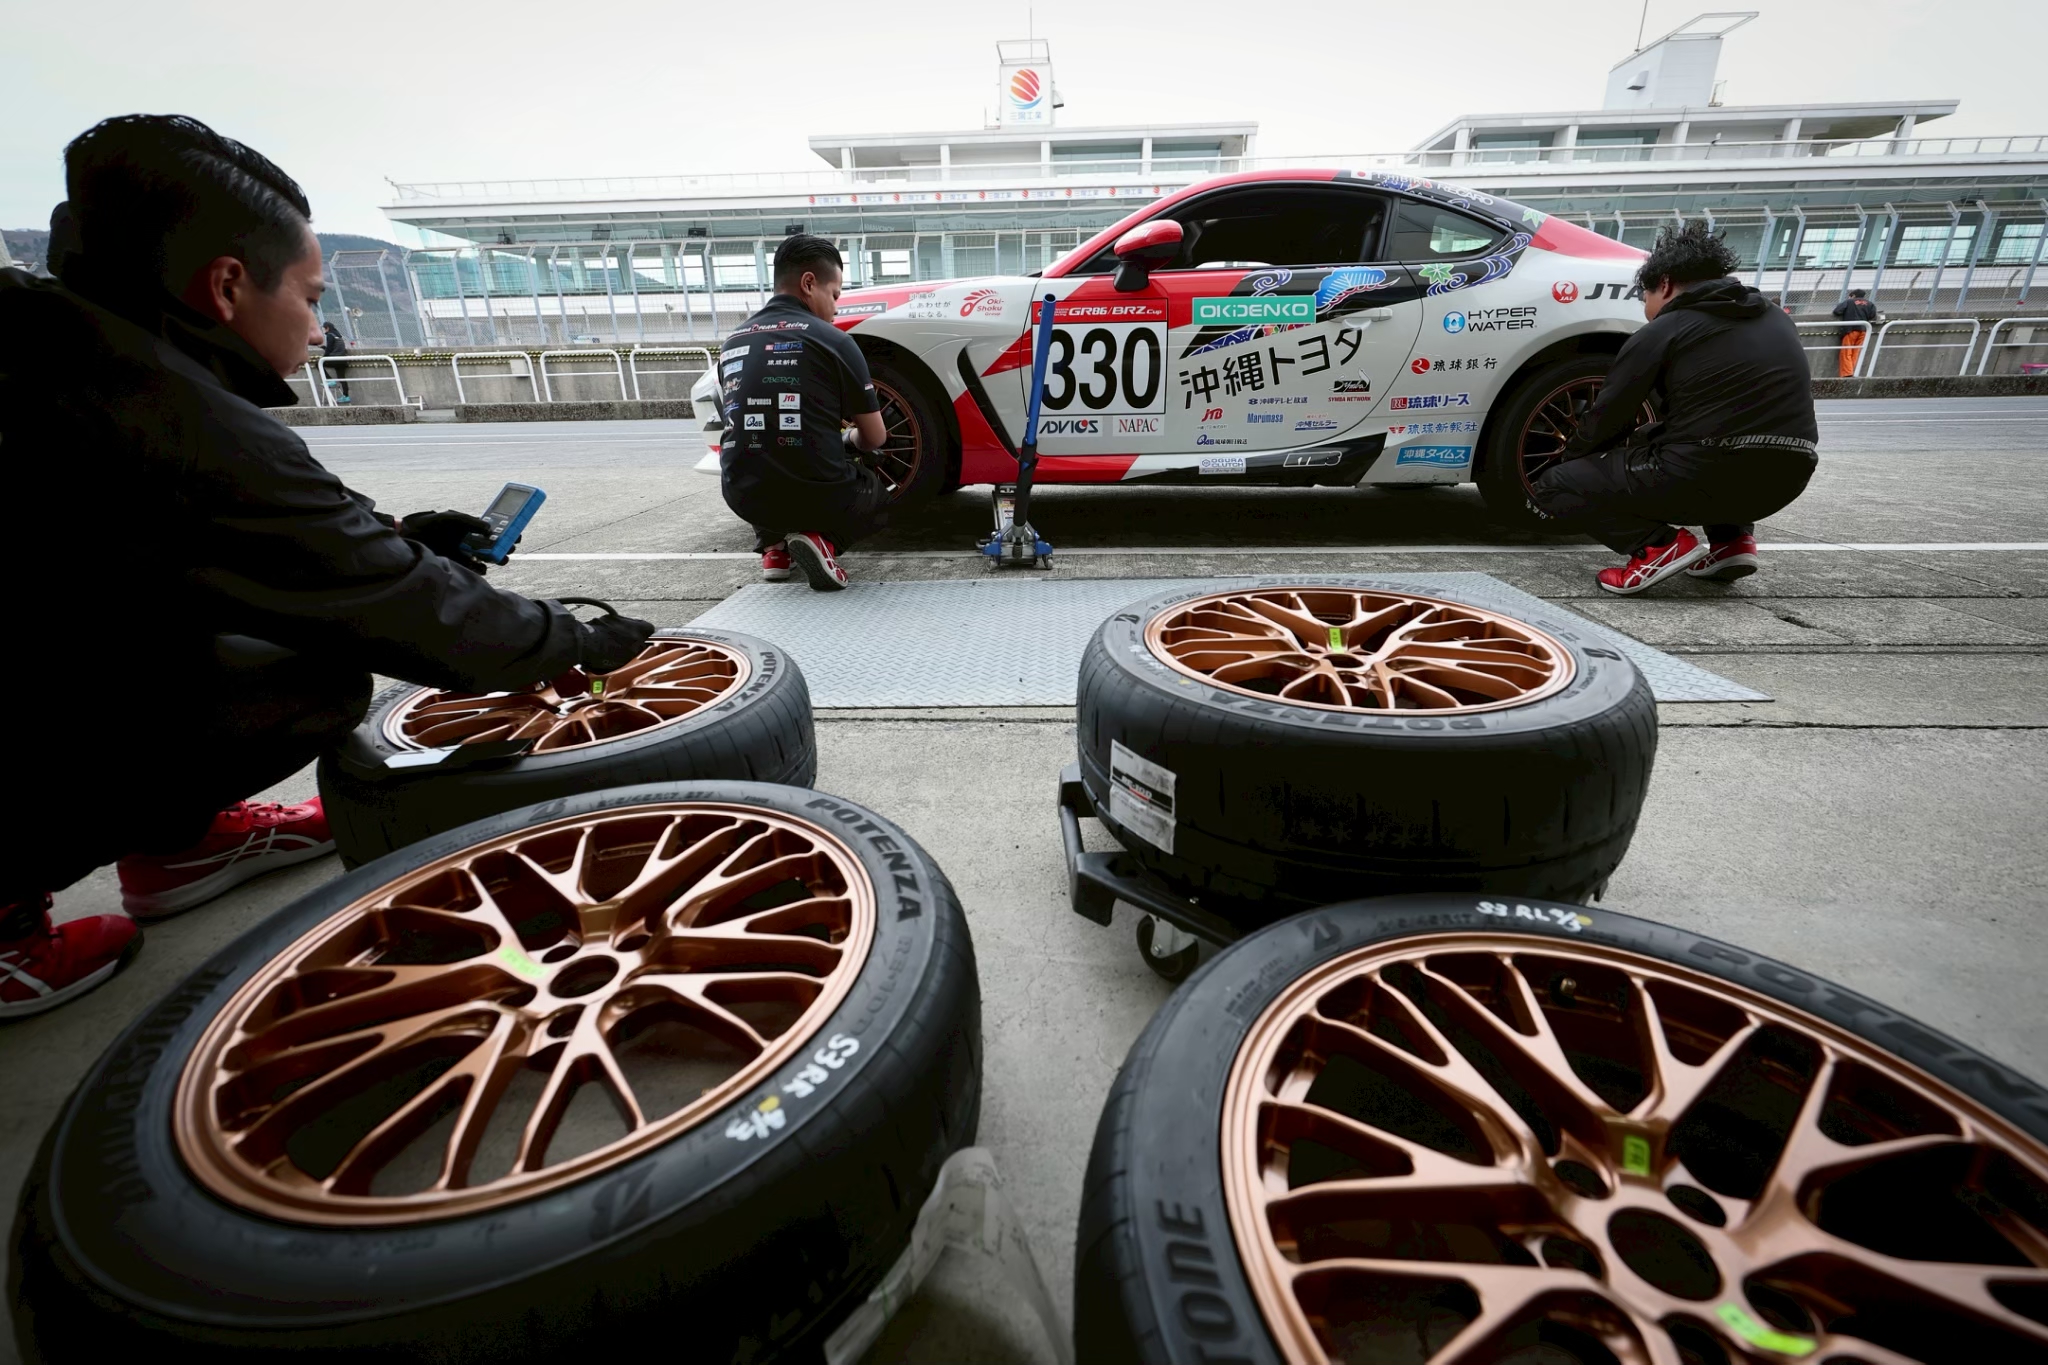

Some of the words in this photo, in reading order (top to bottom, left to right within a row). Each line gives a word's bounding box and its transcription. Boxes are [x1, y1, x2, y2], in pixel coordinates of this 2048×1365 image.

[1437, 183, 1494, 206] RECARO
[1584, 283, 1643, 300] JTA
[977, 304, 1003, 312] Shoku
[1468, 306, 1537, 320] HYPER
[1468, 319, 1535, 332] WATER
[1041, 327, 1161, 410] 330
[1179, 327, 1363, 410] 沖縄トヨタ
[1433, 357, 1498, 372] 琉球銀行
[762, 376, 800, 386] OBERON
[783, 395, 796, 403] JTB
[1259, 396, 1308, 405] 沖縄テレビ放送
[1408, 393, 1469, 409] 琉球リース
[1201, 407, 1224, 422] JTB
[1247, 412, 1283, 424] Marumasa
[1118, 418, 1159, 433] NAPAC
[1407, 421, 1478, 435] 琉球新報社
[1402, 448, 1466, 459] 沖縄タイムス
[713, 651, 778, 712] POTENZA
[1208, 694, 1487, 731] POTENZA
[805, 798, 922, 923] POTENZA
[1475, 901, 1508, 917] S3
[1515, 904, 1550, 922] RL
[1687, 940, 2048, 1120] POTEN
